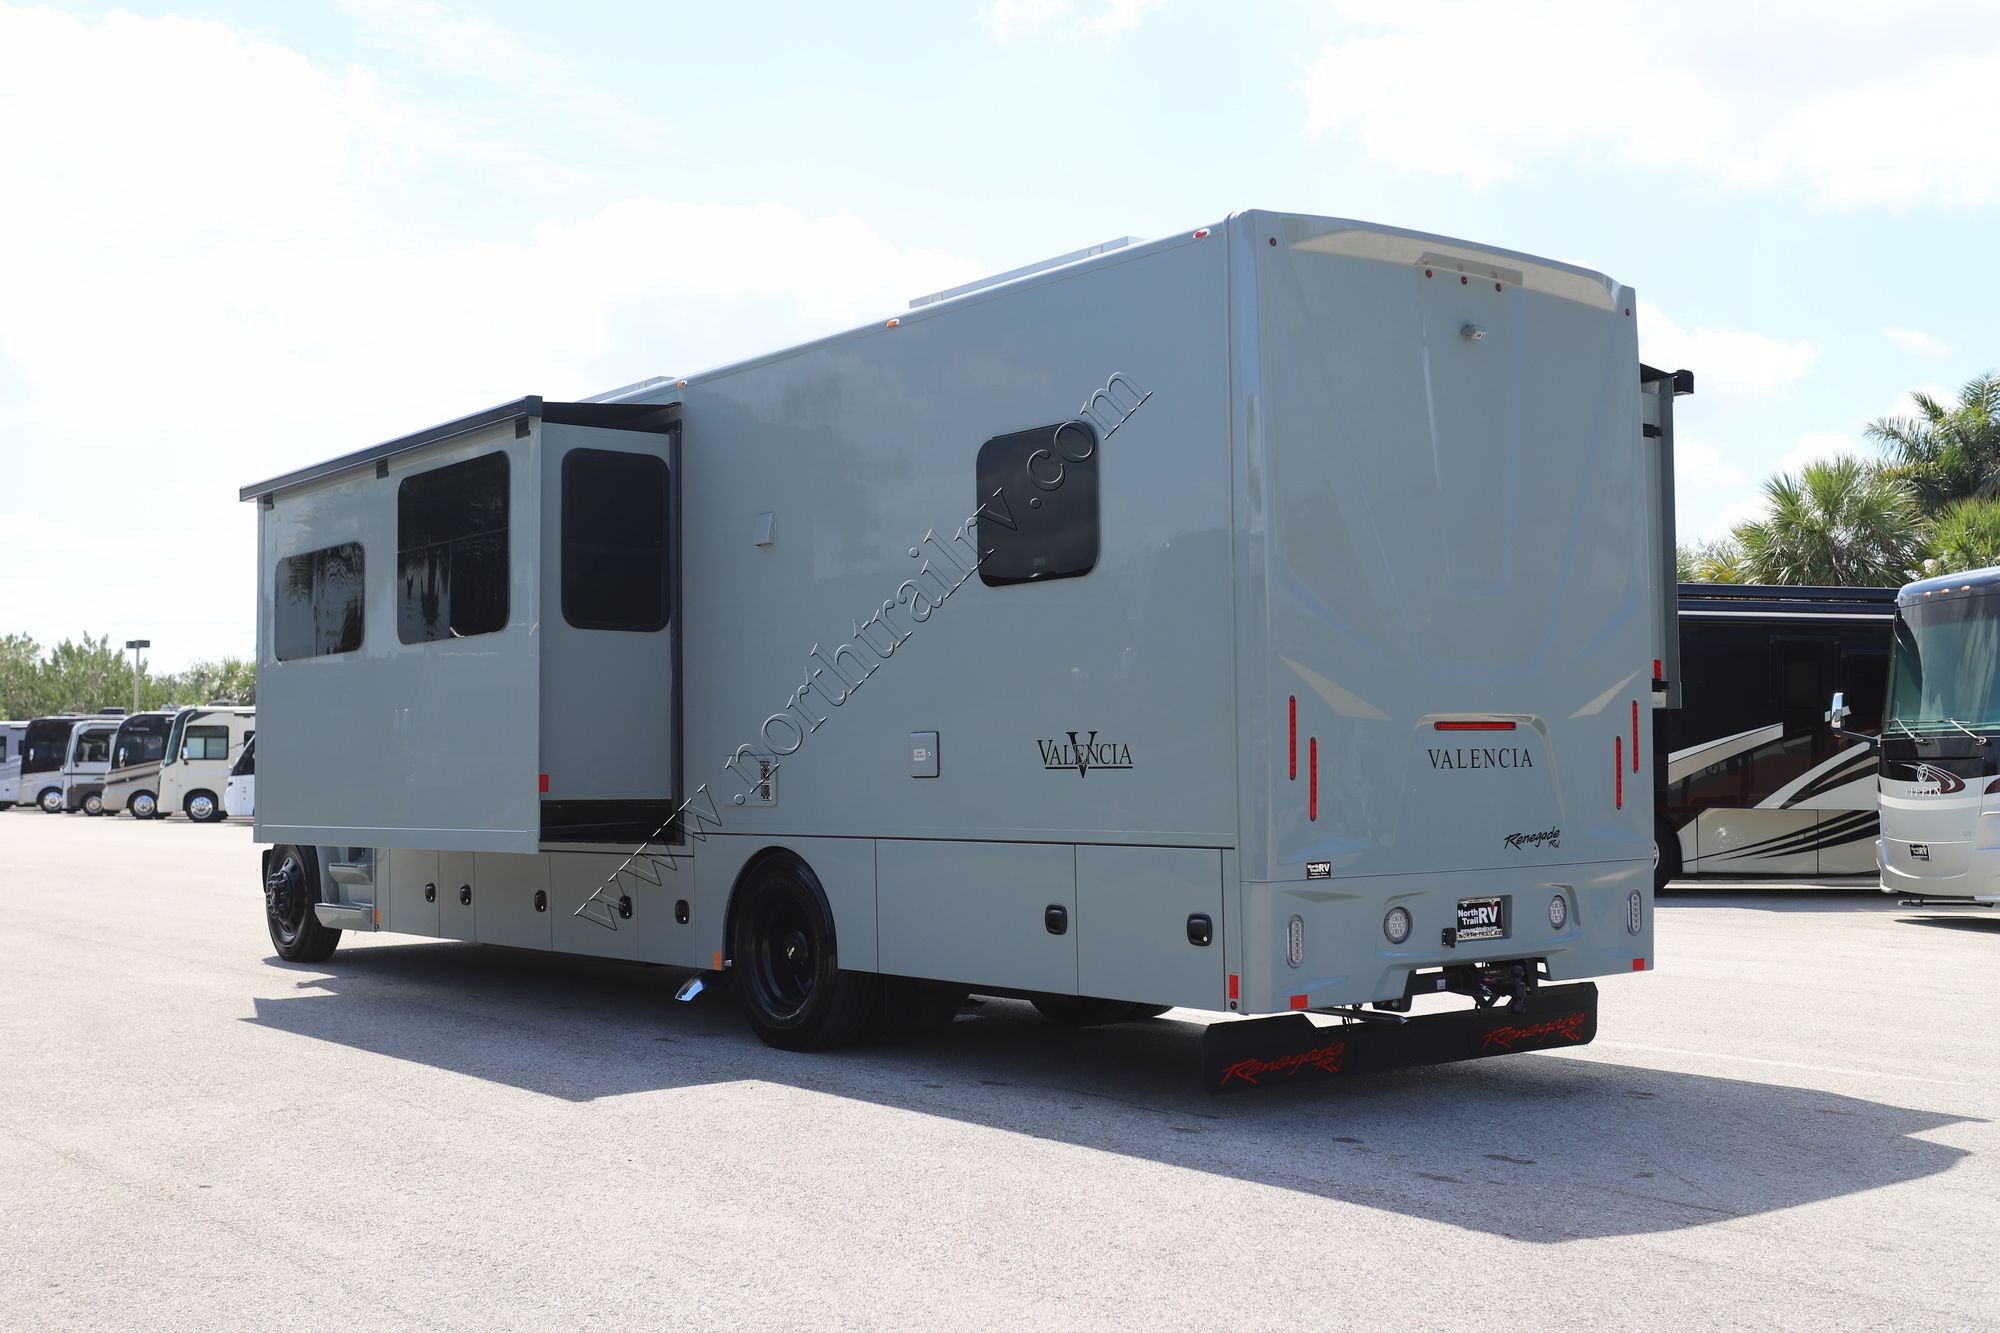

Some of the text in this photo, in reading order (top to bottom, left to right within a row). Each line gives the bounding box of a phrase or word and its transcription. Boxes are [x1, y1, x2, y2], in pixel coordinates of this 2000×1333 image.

[1037, 739, 1133, 765] VALENCIA
[1427, 748, 1533, 769] VALENCIA
[1504, 826, 1560, 850] Renegade
[1319, 863, 1330, 872] RV
[1457, 906, 1498, 924] North RV
[1462, 916, 1479, 925] Trail
[1482, 1013, 1584, 1049] Renegade
[1221, 1042, 1345, 1085] Renegade
